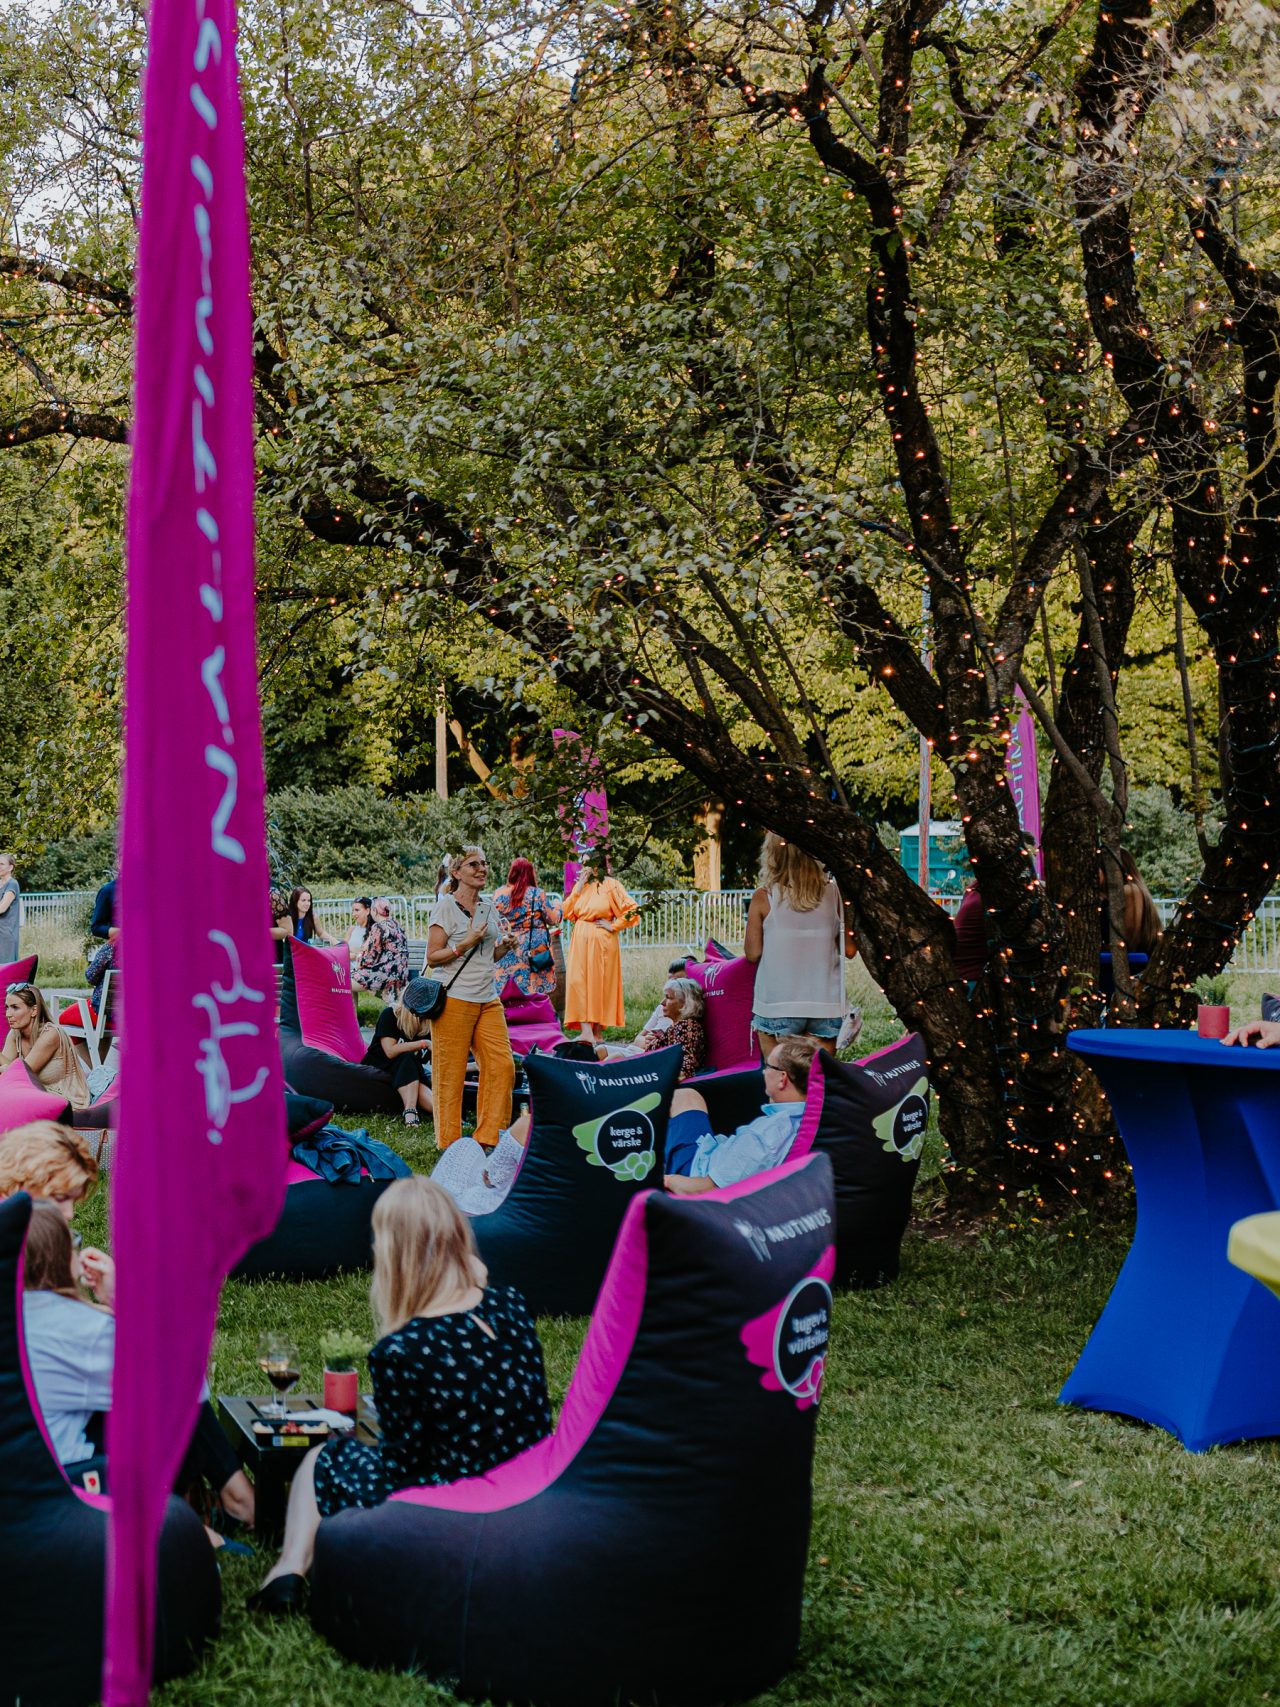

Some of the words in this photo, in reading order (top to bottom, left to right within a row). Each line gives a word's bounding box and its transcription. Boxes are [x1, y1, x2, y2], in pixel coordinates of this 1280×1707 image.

[598, 1072, 659, 1087] NAUTIMUS
[609, 1126, 636, 1138] kerge
[636, 1126, 644, 1135] &
[611, 1138, 642, 1148] värske
[764, 1207, 832, 1243] NAUTIMUS
